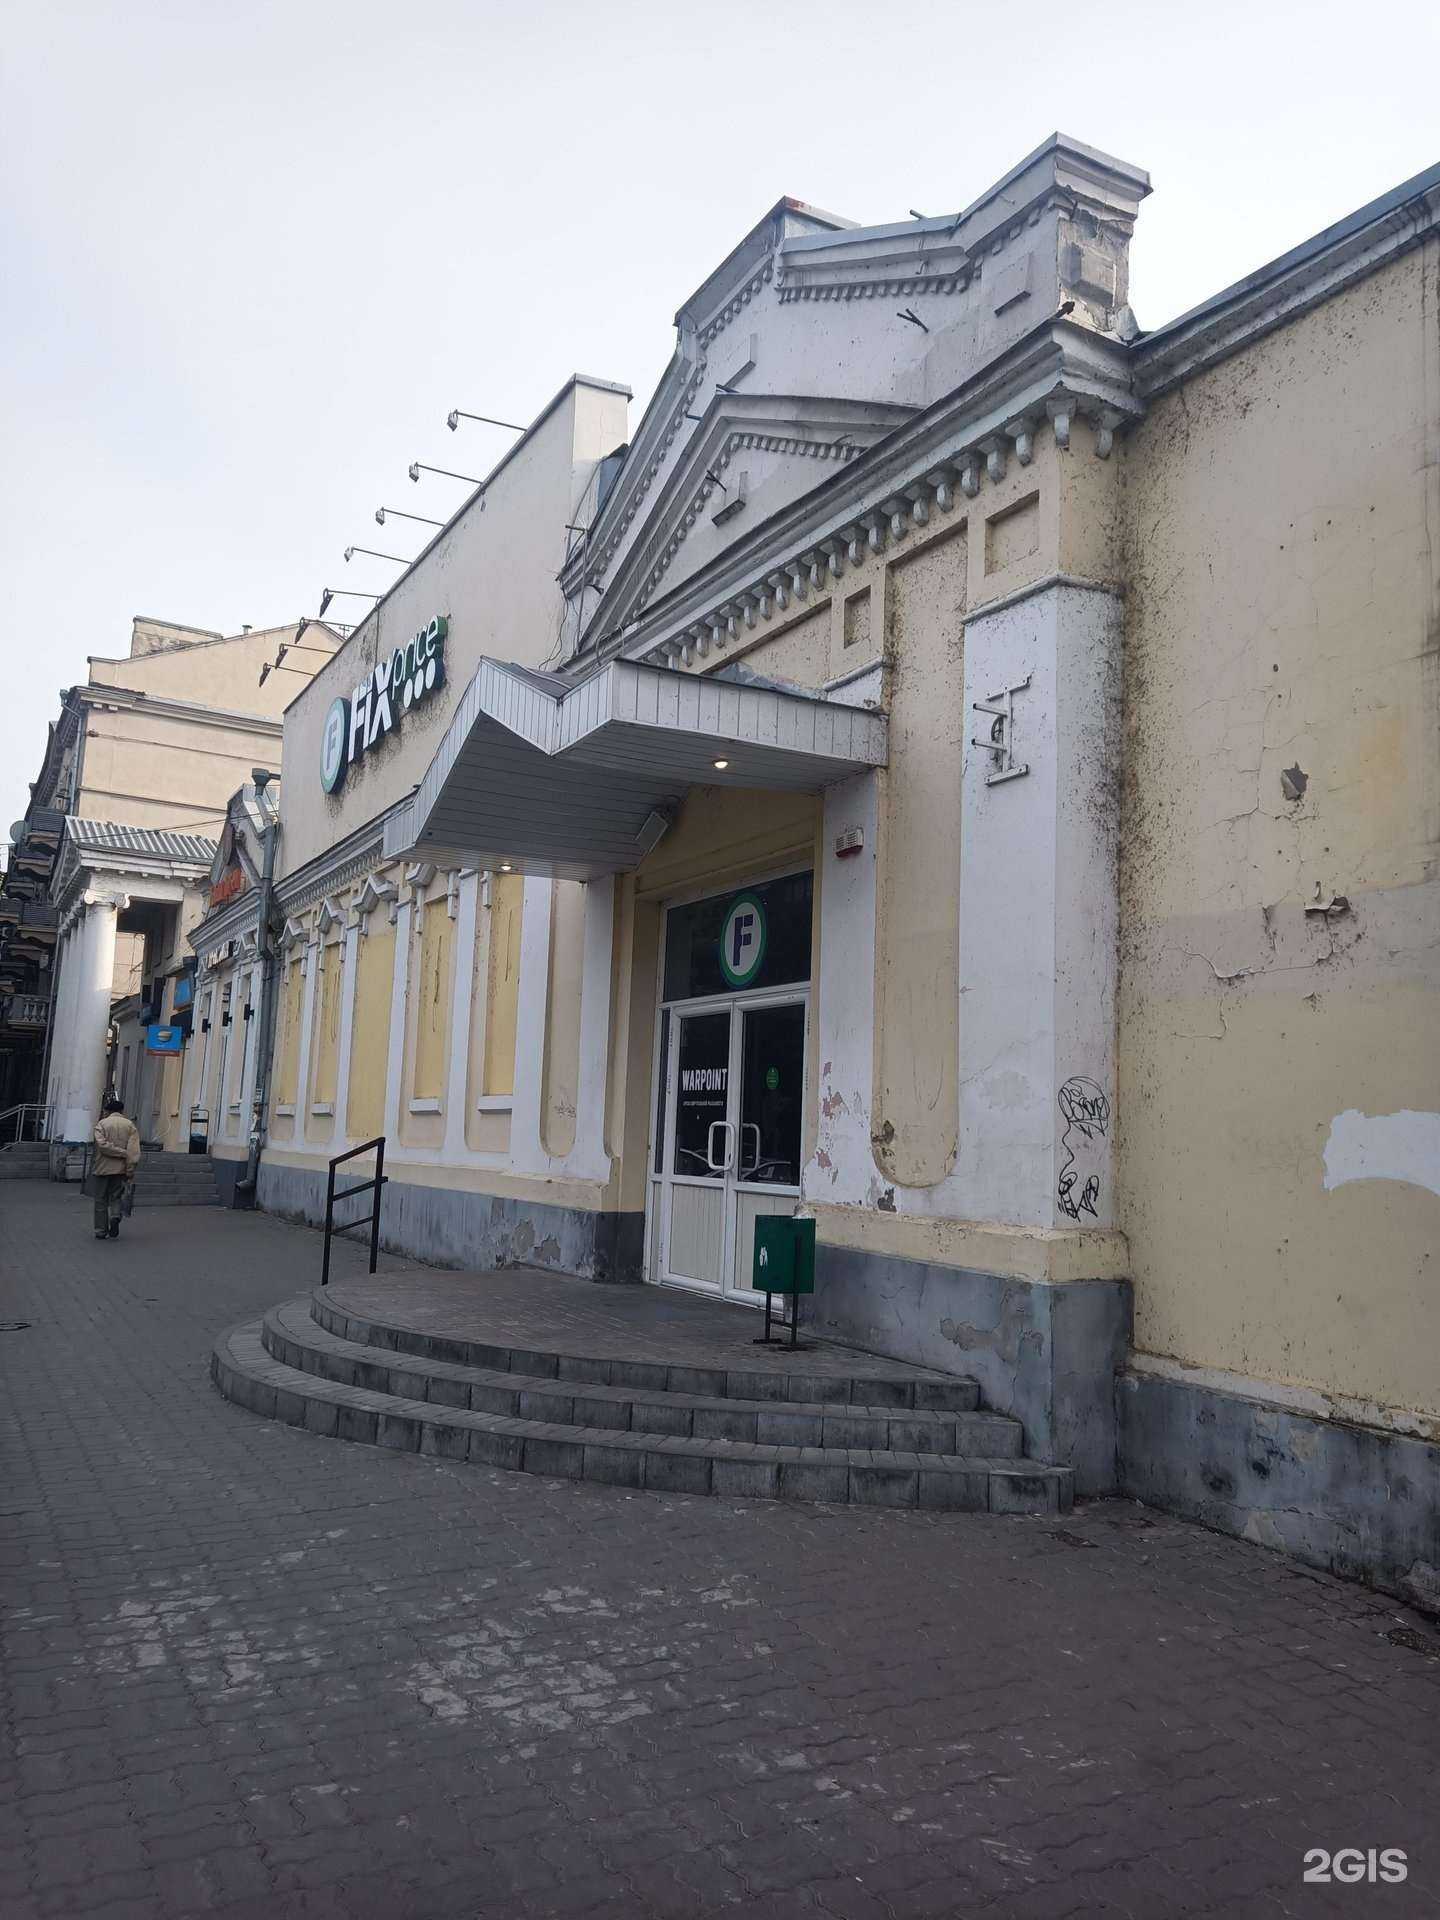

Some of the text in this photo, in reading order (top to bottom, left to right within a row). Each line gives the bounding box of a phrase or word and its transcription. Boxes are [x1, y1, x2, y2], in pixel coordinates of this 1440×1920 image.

[391, 614, 438, 700] price
[733, 913, 754, 966] F
[682, 1068, 728, 1091] WARPOINT
